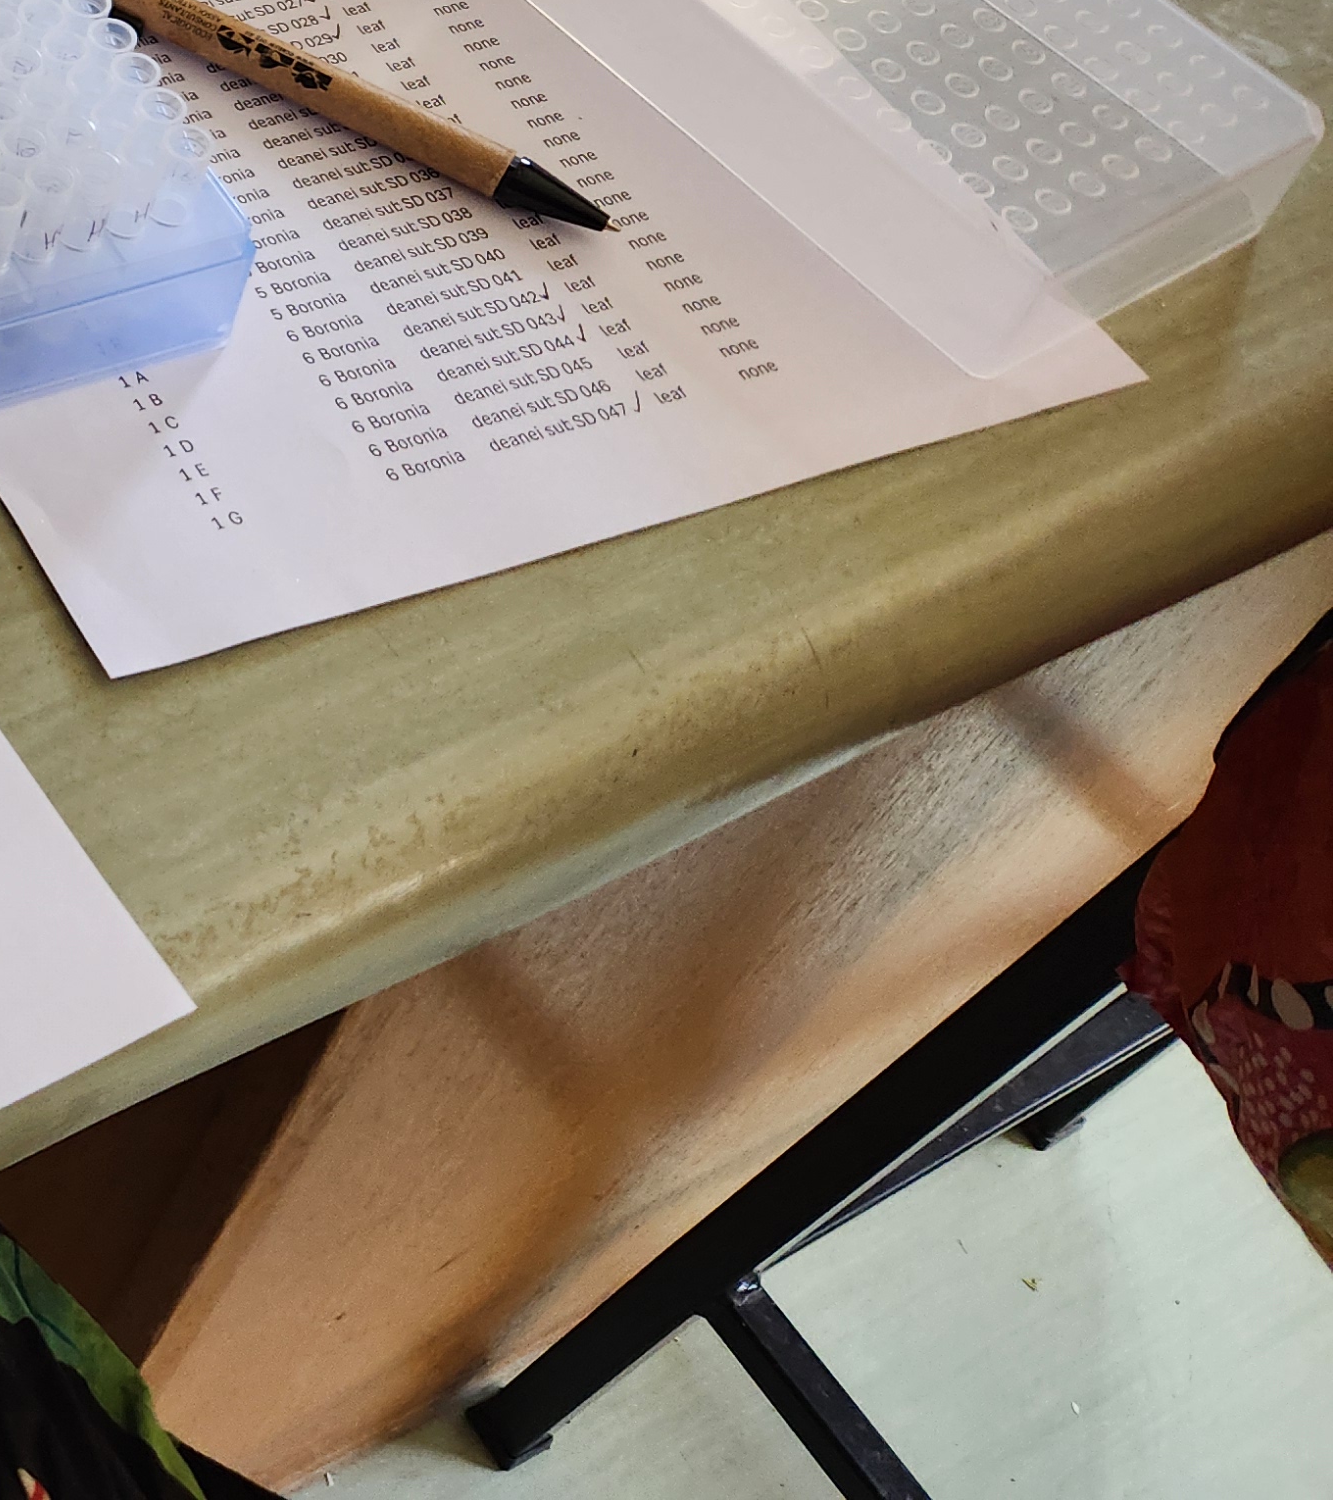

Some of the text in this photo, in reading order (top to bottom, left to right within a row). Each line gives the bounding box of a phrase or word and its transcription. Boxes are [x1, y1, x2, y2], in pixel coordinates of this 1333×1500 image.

[118, 370, 150, 389] 1 A
[319, 375, 332, 387] 6
[334, 357, 397, 383] Boronia
[419, 334, 474, 360] deanei
[502, 320, 526, 336] SD
[526, 312, 558, 330] 043
[581, 296, 614, 315] leaf
[663, 272, 704, 293] none
[335, 397, 348, 410] 6
[351, 379, 414, 406] Boronia
[436, 356, 491, 382] deanei
[518, 343, 543, 359] SD
[544, 334, 575, 353] 044
[599, 318, 632, 337] leaf
[682, 293, 722, 314] none
[148, 415, 179, 434] 1 C
[368, 444, 382, 457] 6
[384, 426, 448, 453] Boronia
[471, 402, 526, 428] deanei
[554, 388, 579, 405] SD
[579, 379, 611, 397] 046
[635, 363, 668, 382] leaf
[719, 337, 760, 358] none
[386, 468, 400, 481] 6
[401, 449, 466, 477] Boronia
[489, 426, 545, 452] deanei
[571, 411, 597, 428] SD
[597, 402, 626, 421] 047
[653, 385, 687, 405] leaf
[738, 360, 779, 382] none
[211, 511, 244, 530] 1 G
